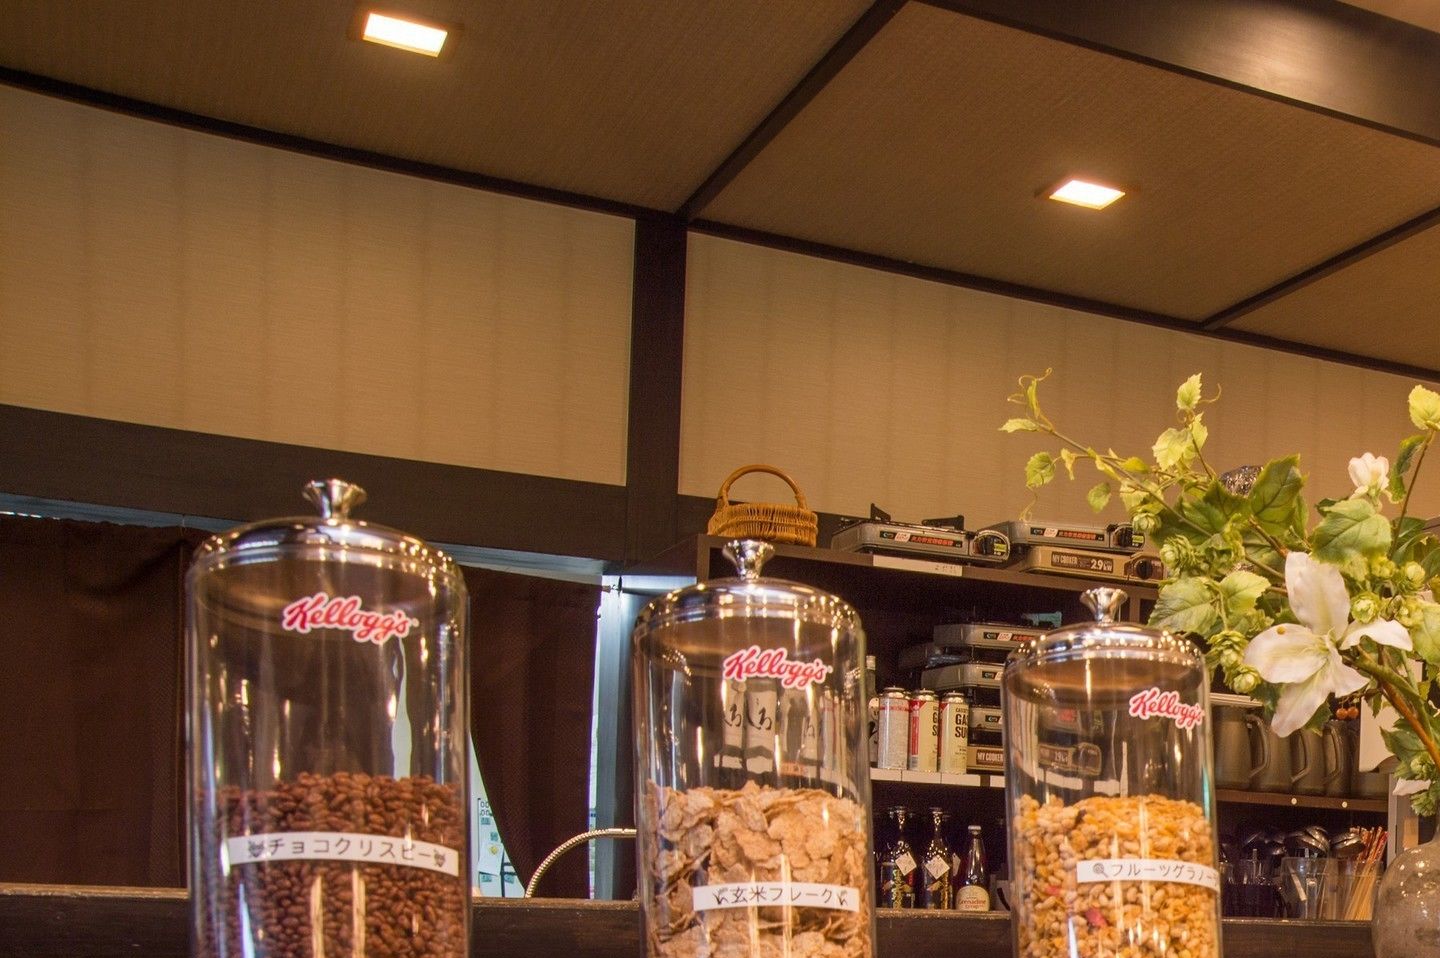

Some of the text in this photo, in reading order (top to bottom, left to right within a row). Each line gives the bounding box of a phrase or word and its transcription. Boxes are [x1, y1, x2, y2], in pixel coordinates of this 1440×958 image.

[284, 592, 412, 644] Kellogg's
[724, 647, 827, 688] Kellogg's
[955, 713, 969, 725] GA
[1130, 688, 1204, 728] Kellogg's
[268, 837, 433, 861] チョコクリスピー
[731, 886, 833, 905] 玄米フレーク
